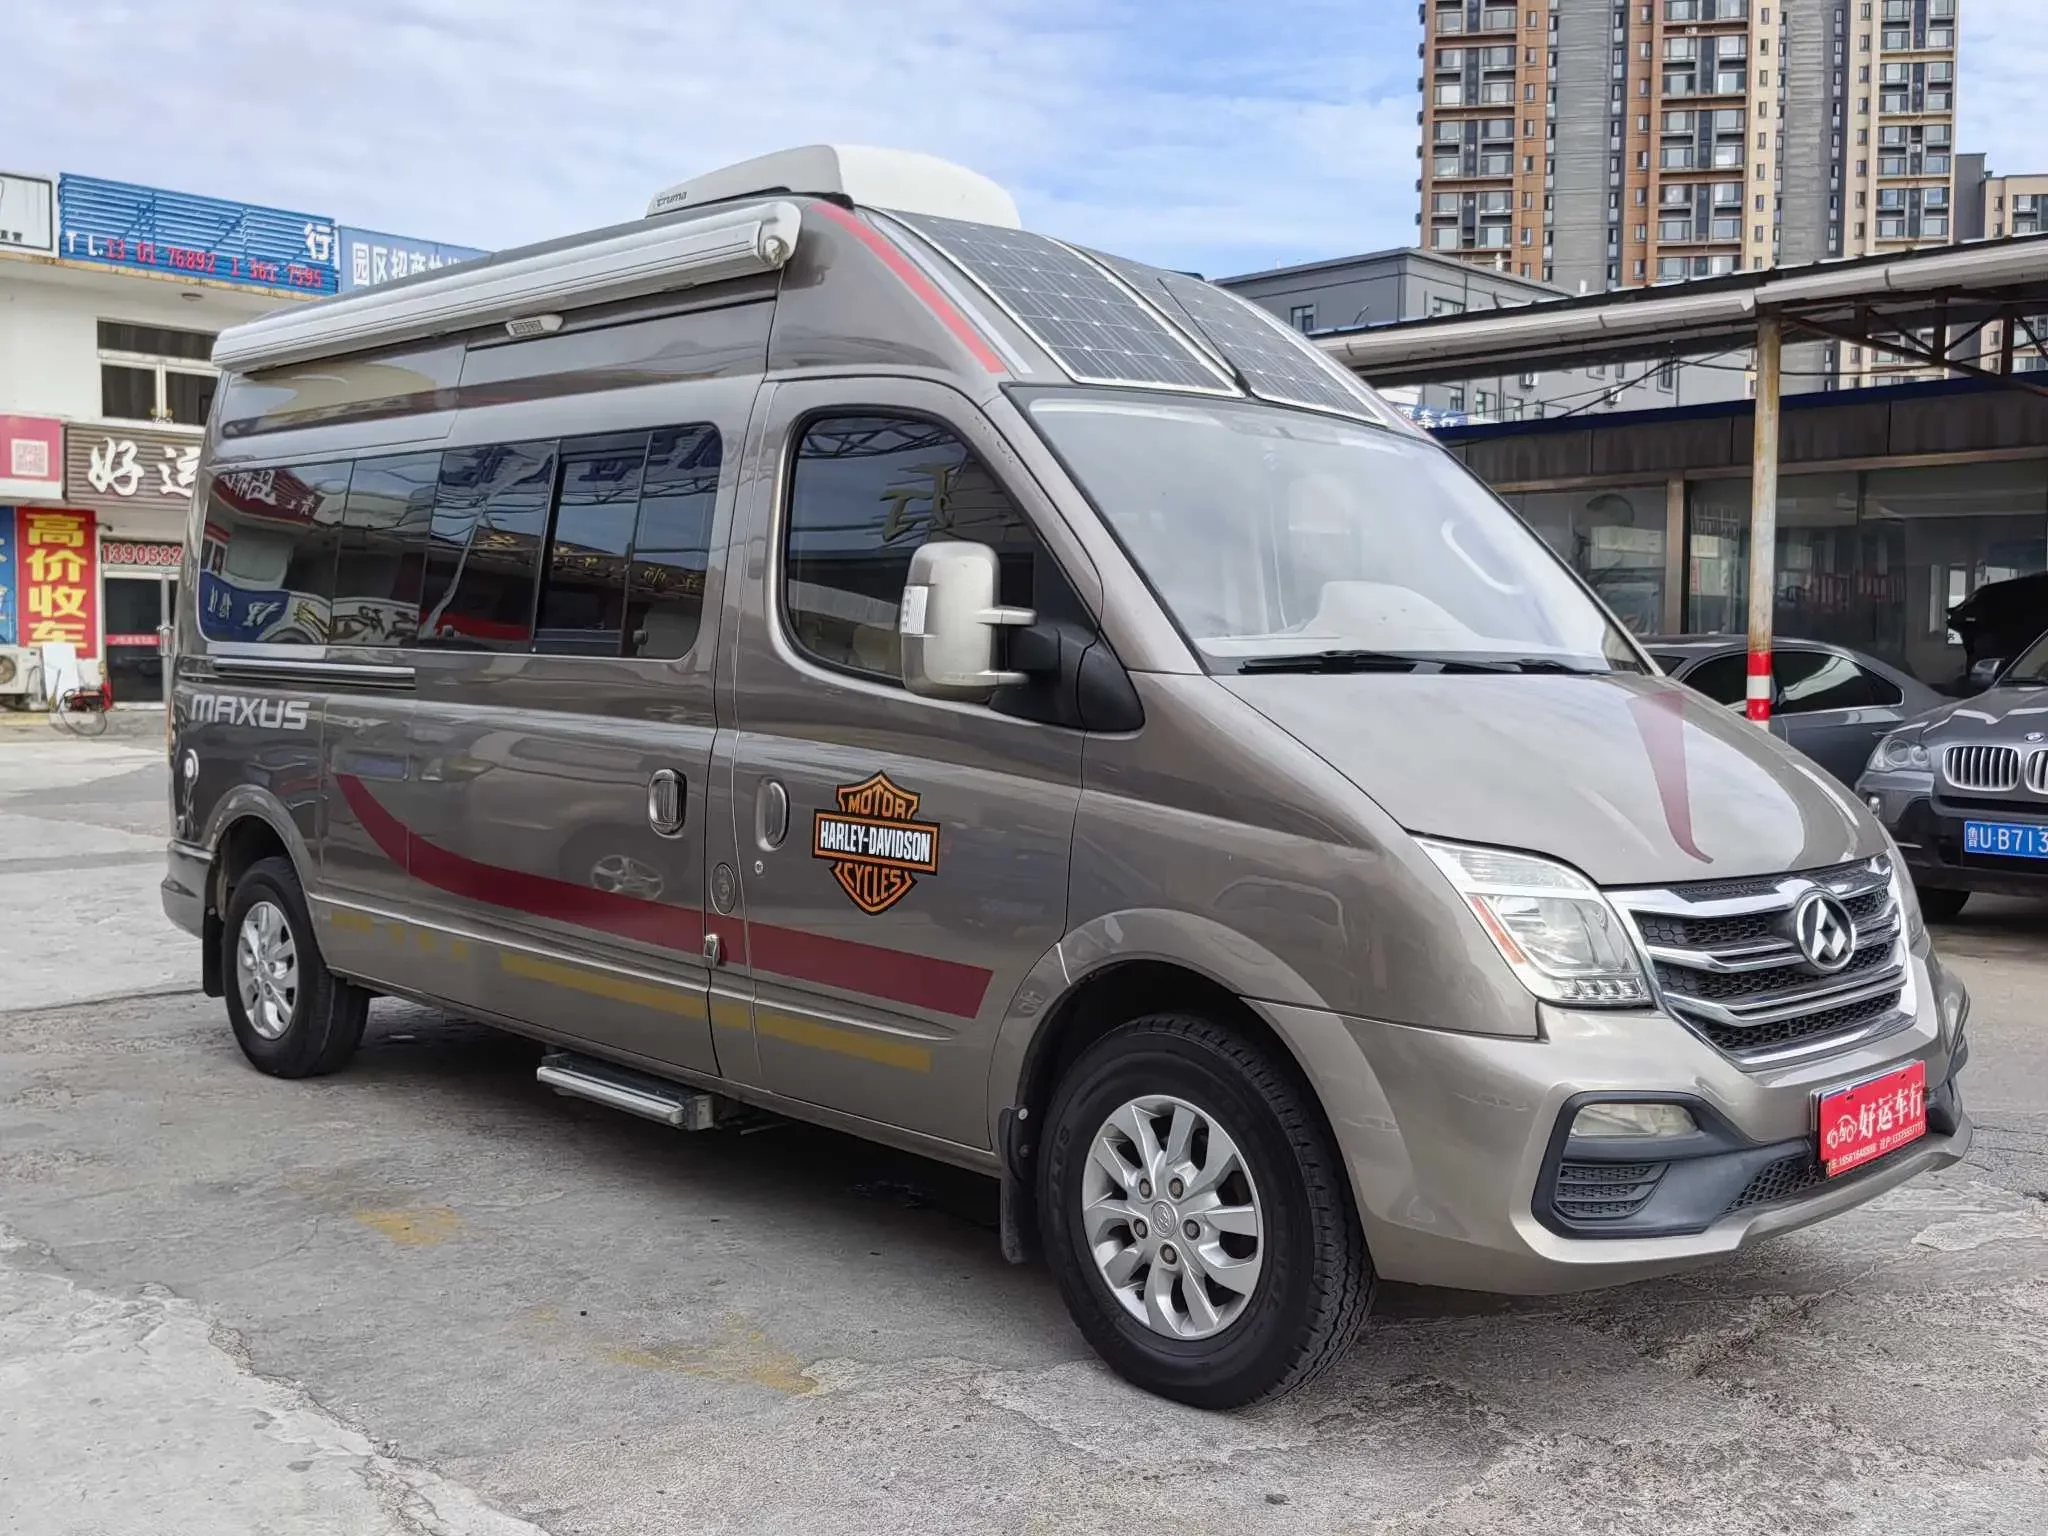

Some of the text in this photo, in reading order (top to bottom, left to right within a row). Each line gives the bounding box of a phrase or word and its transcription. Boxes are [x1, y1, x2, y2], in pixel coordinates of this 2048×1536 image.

[303, 222, 333, 260] 行
[24, 513, 88, 650] 高价收车
[191, 693, 311, 730] MAXUS
[847, 783, 907, 820] MOTOR
[820, 820, 931, 863] HARLEY-DAVIDSON
[843, 862, 901, 905] CYCLES
[1858, 1081, 1924, 1140] 好运车行
